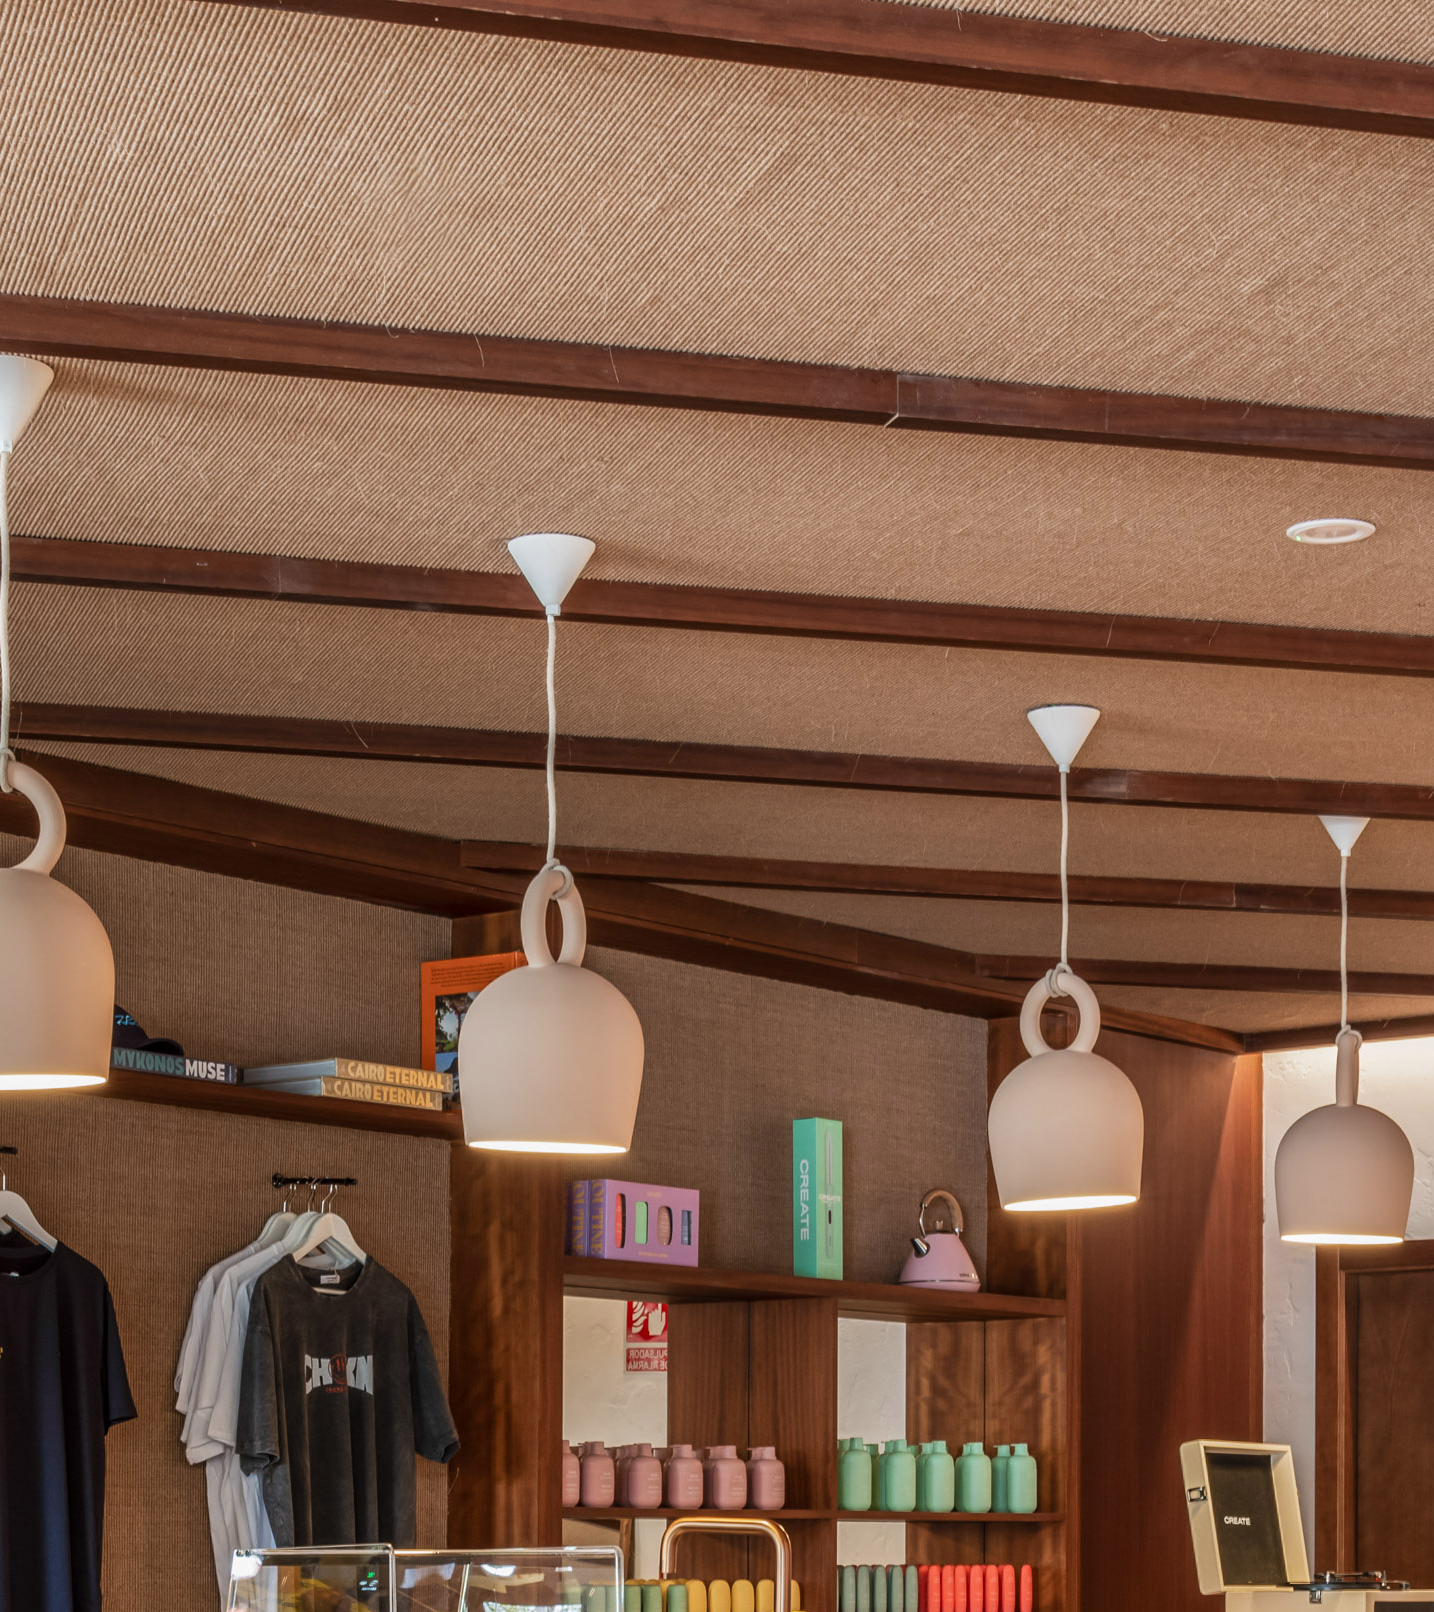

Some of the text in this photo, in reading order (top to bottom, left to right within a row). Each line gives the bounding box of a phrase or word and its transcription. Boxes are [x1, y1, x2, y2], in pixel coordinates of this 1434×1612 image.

[114, 1049, 225, 1081] MYKONOS MUSE
[348, 1061, 444, 1090] CAIRO ETERNAL
[334, 1081, 433, 1108] CAIRO ETERNAL
[799, 1159, 810, 1241] CREATE
[1224, 1516, 1251, 1527] CREATE
